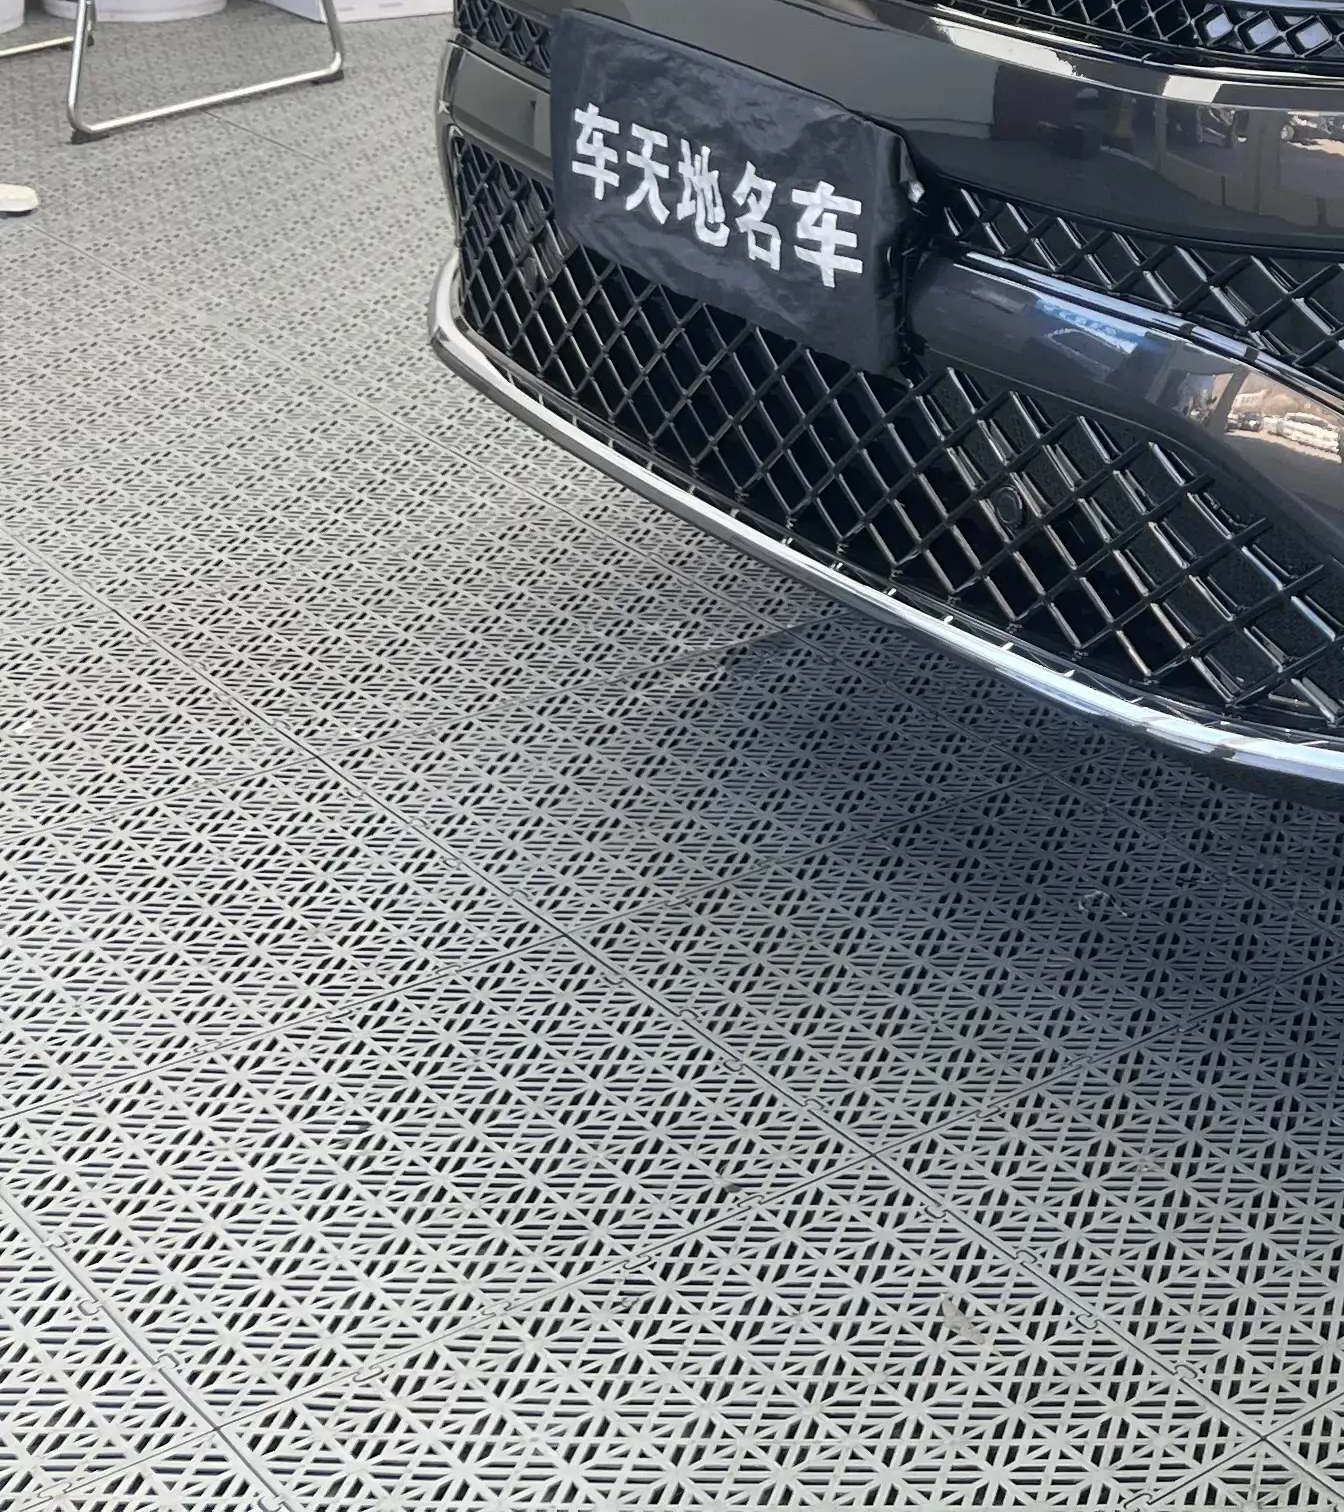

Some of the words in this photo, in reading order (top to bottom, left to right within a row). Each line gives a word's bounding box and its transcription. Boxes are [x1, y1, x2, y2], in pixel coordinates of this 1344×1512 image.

[572, 102, 864, 288] 车天地名车
